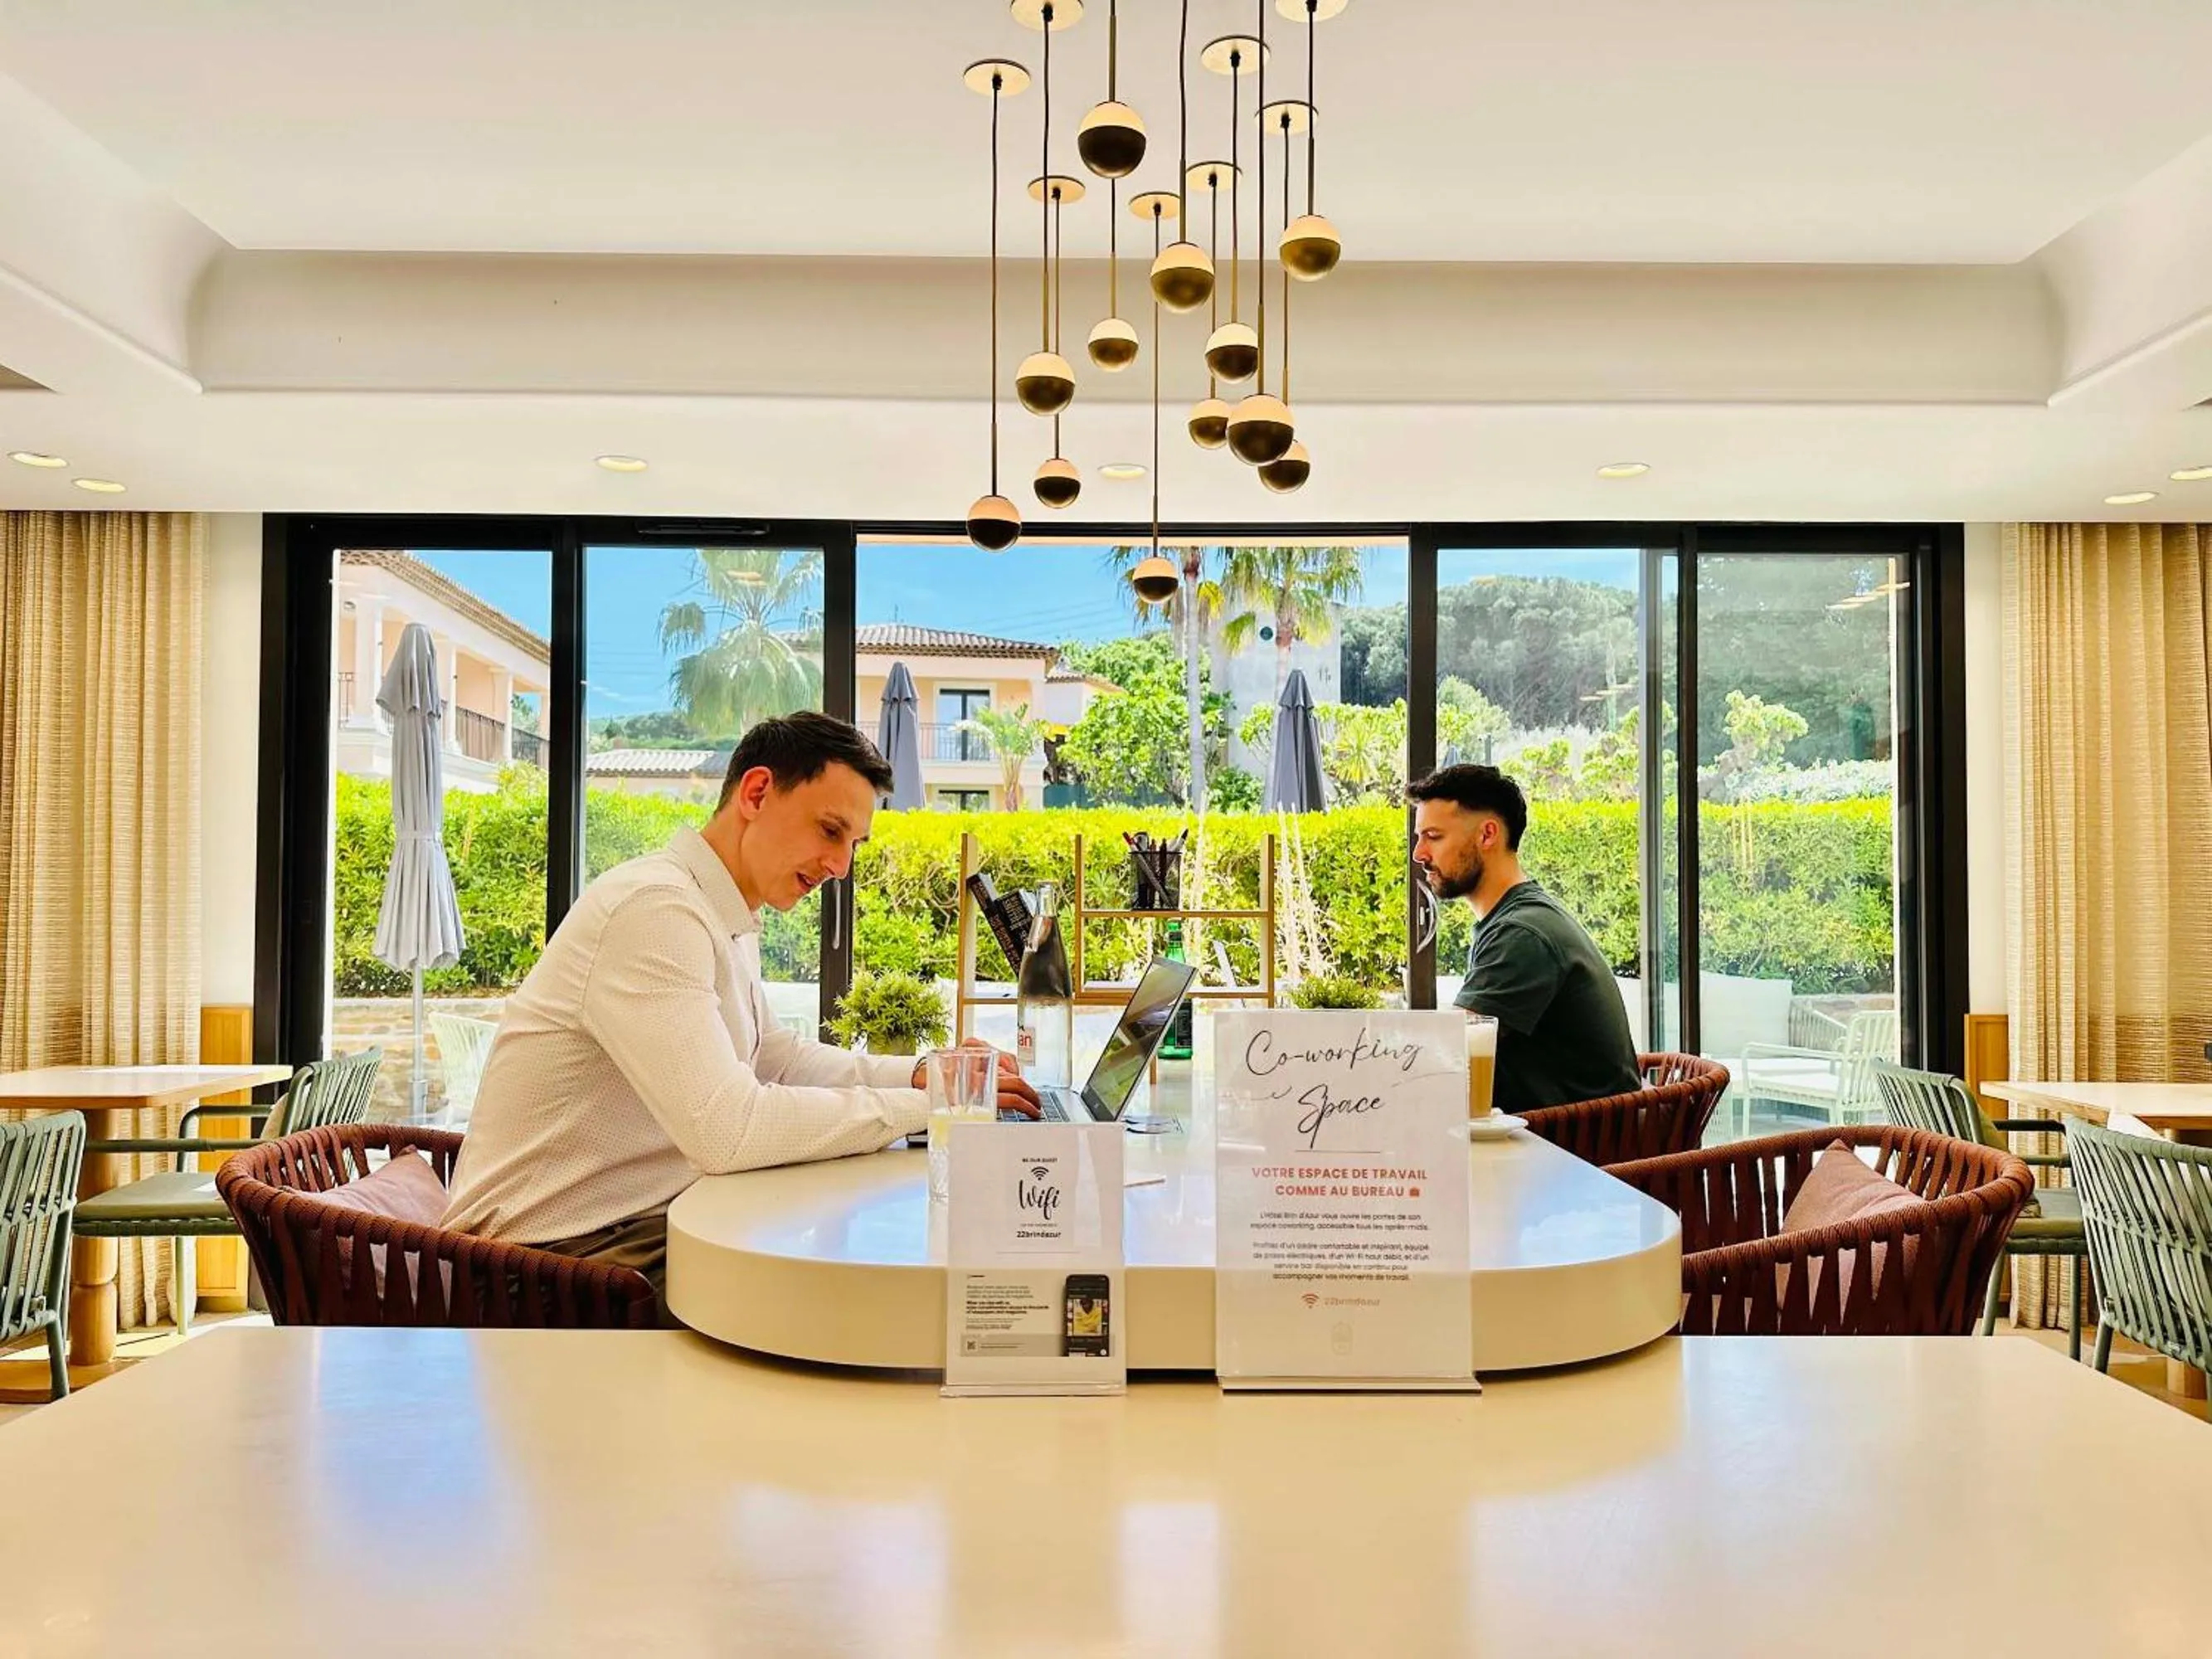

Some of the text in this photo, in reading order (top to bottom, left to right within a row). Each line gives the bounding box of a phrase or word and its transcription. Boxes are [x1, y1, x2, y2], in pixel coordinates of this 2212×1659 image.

[1246, 1028, 1424, 1076] Co-working
[1297, 1083, 1384, 1150] Space
[1252, 1167, 1428, 1180] VOTRE ESPACE DE TRAVAIL
[1018, 1180, 1061, 1221] Wifi
[1275, 1185, 1405, 1197] COMME AU BUREAU
[1272, 1273, 1323, 1282] accompagner
